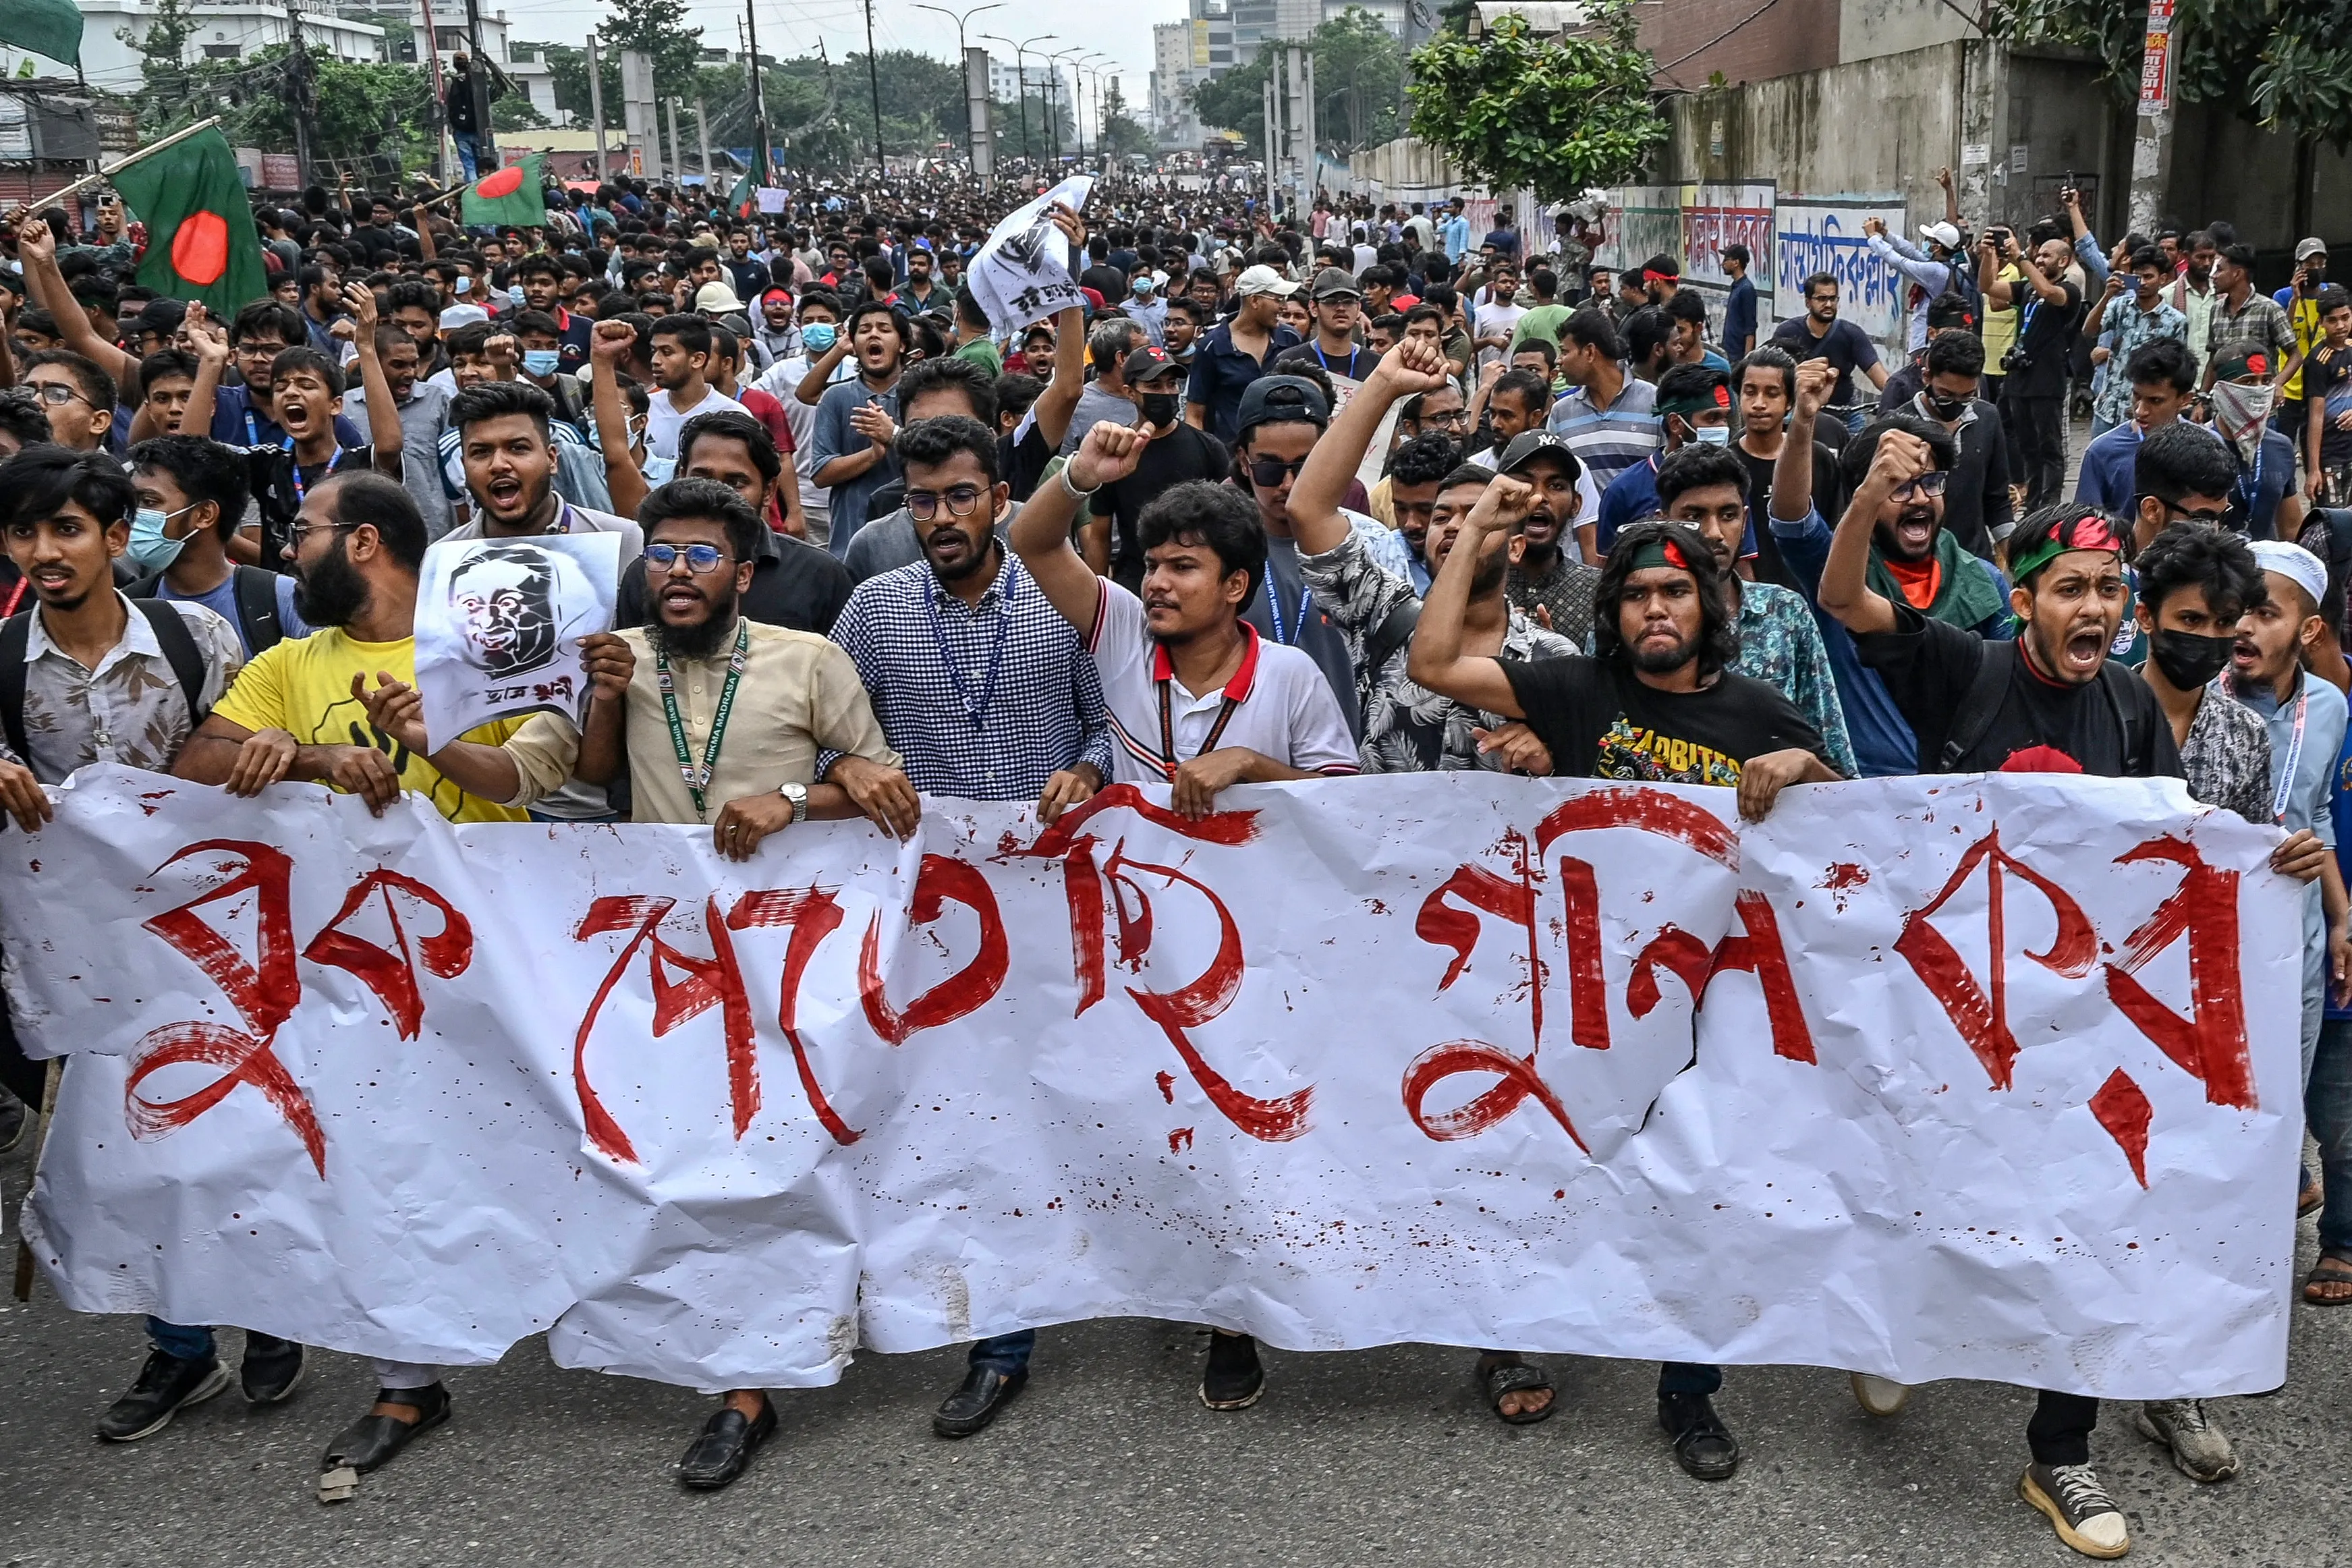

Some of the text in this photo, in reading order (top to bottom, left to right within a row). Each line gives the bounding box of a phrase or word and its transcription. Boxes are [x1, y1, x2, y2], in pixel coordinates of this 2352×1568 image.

[706, 677, 737, 762] HIKMA MADRASA
[126, 784, 2258, 1188] বুক পেতেছি গুলি কর
